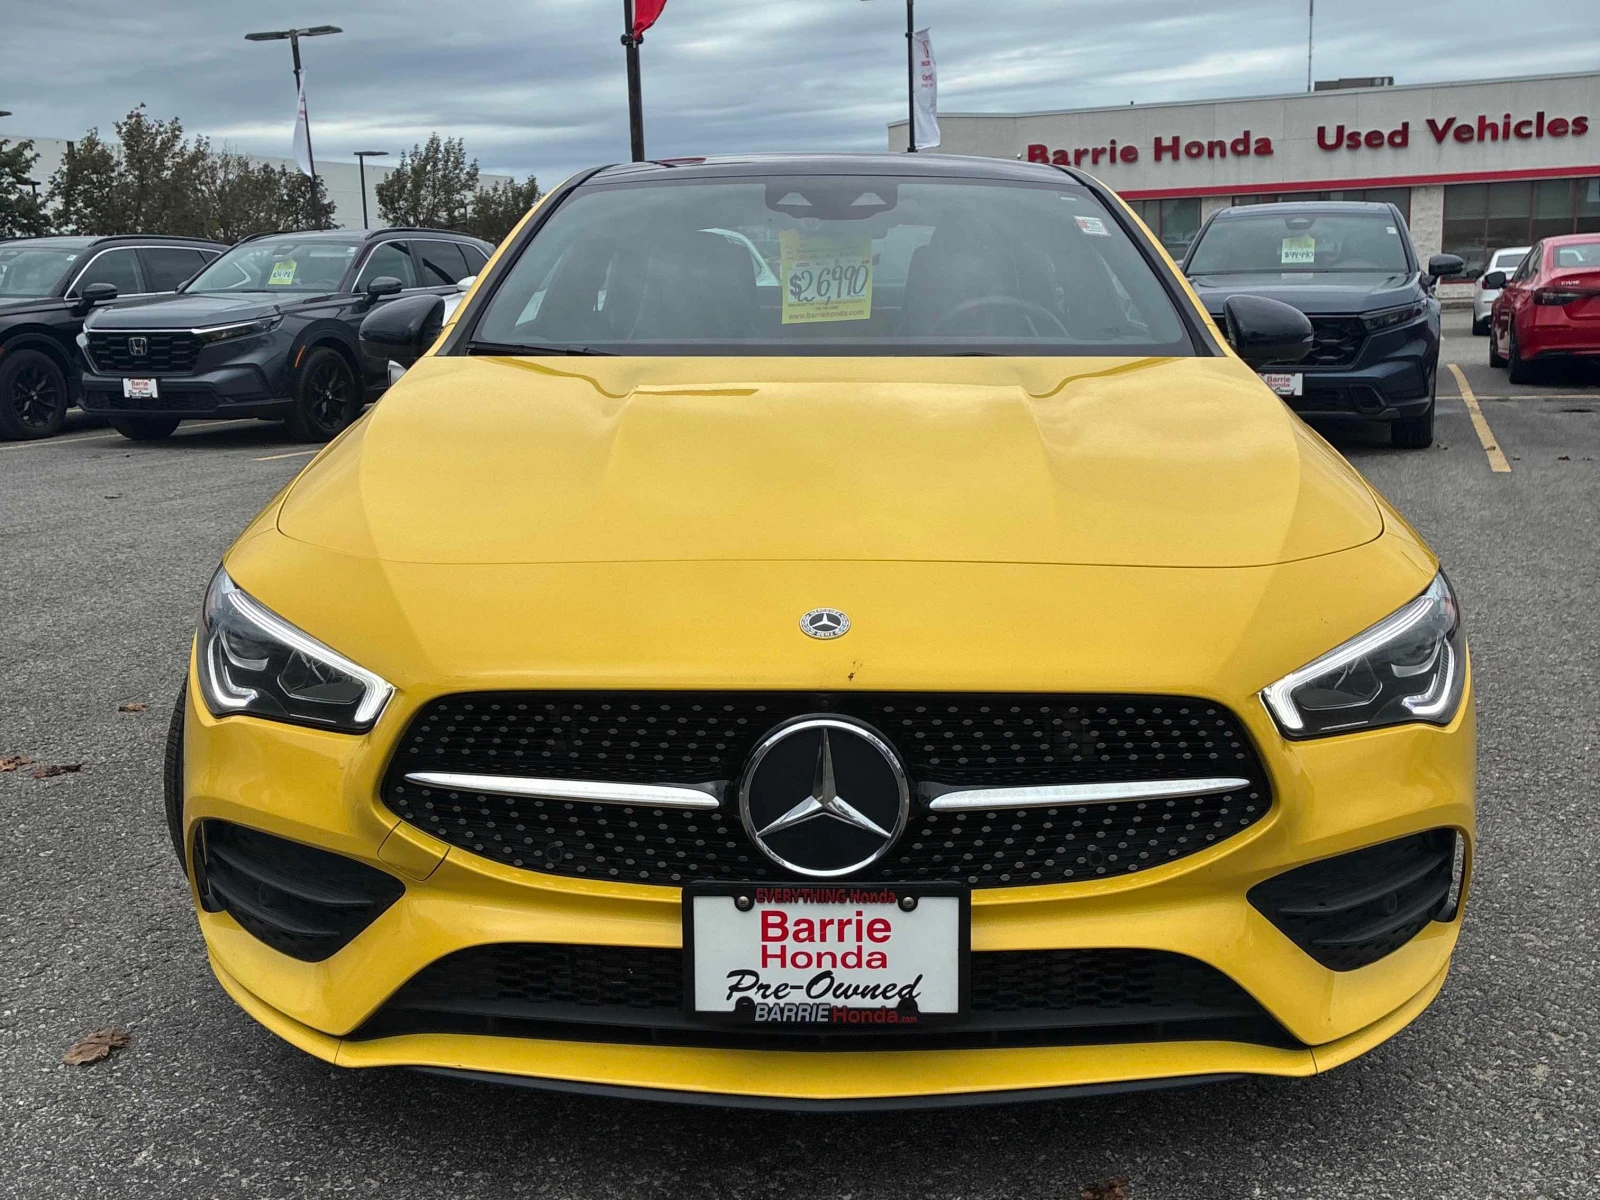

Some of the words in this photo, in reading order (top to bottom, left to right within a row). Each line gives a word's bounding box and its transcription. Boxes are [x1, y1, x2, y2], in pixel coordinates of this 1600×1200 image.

[1027, 139, 1138, 166] Barrie
[1154, 130, 1274, 162] Honda
[1317, 121, 1409, 151] Used
[1426, 111, 1589, 144] Vehicles
[788, 309, 865, 320] www.barriehonda.com
[755, 888, 847, 904] EVERYTHING
[849, 888, 896, 904] Honda
[760, 910, 892, 943] Barrie
[761, 945, 887, 969] Honda
[726, 969, 923, 1001] Pre-Owned
